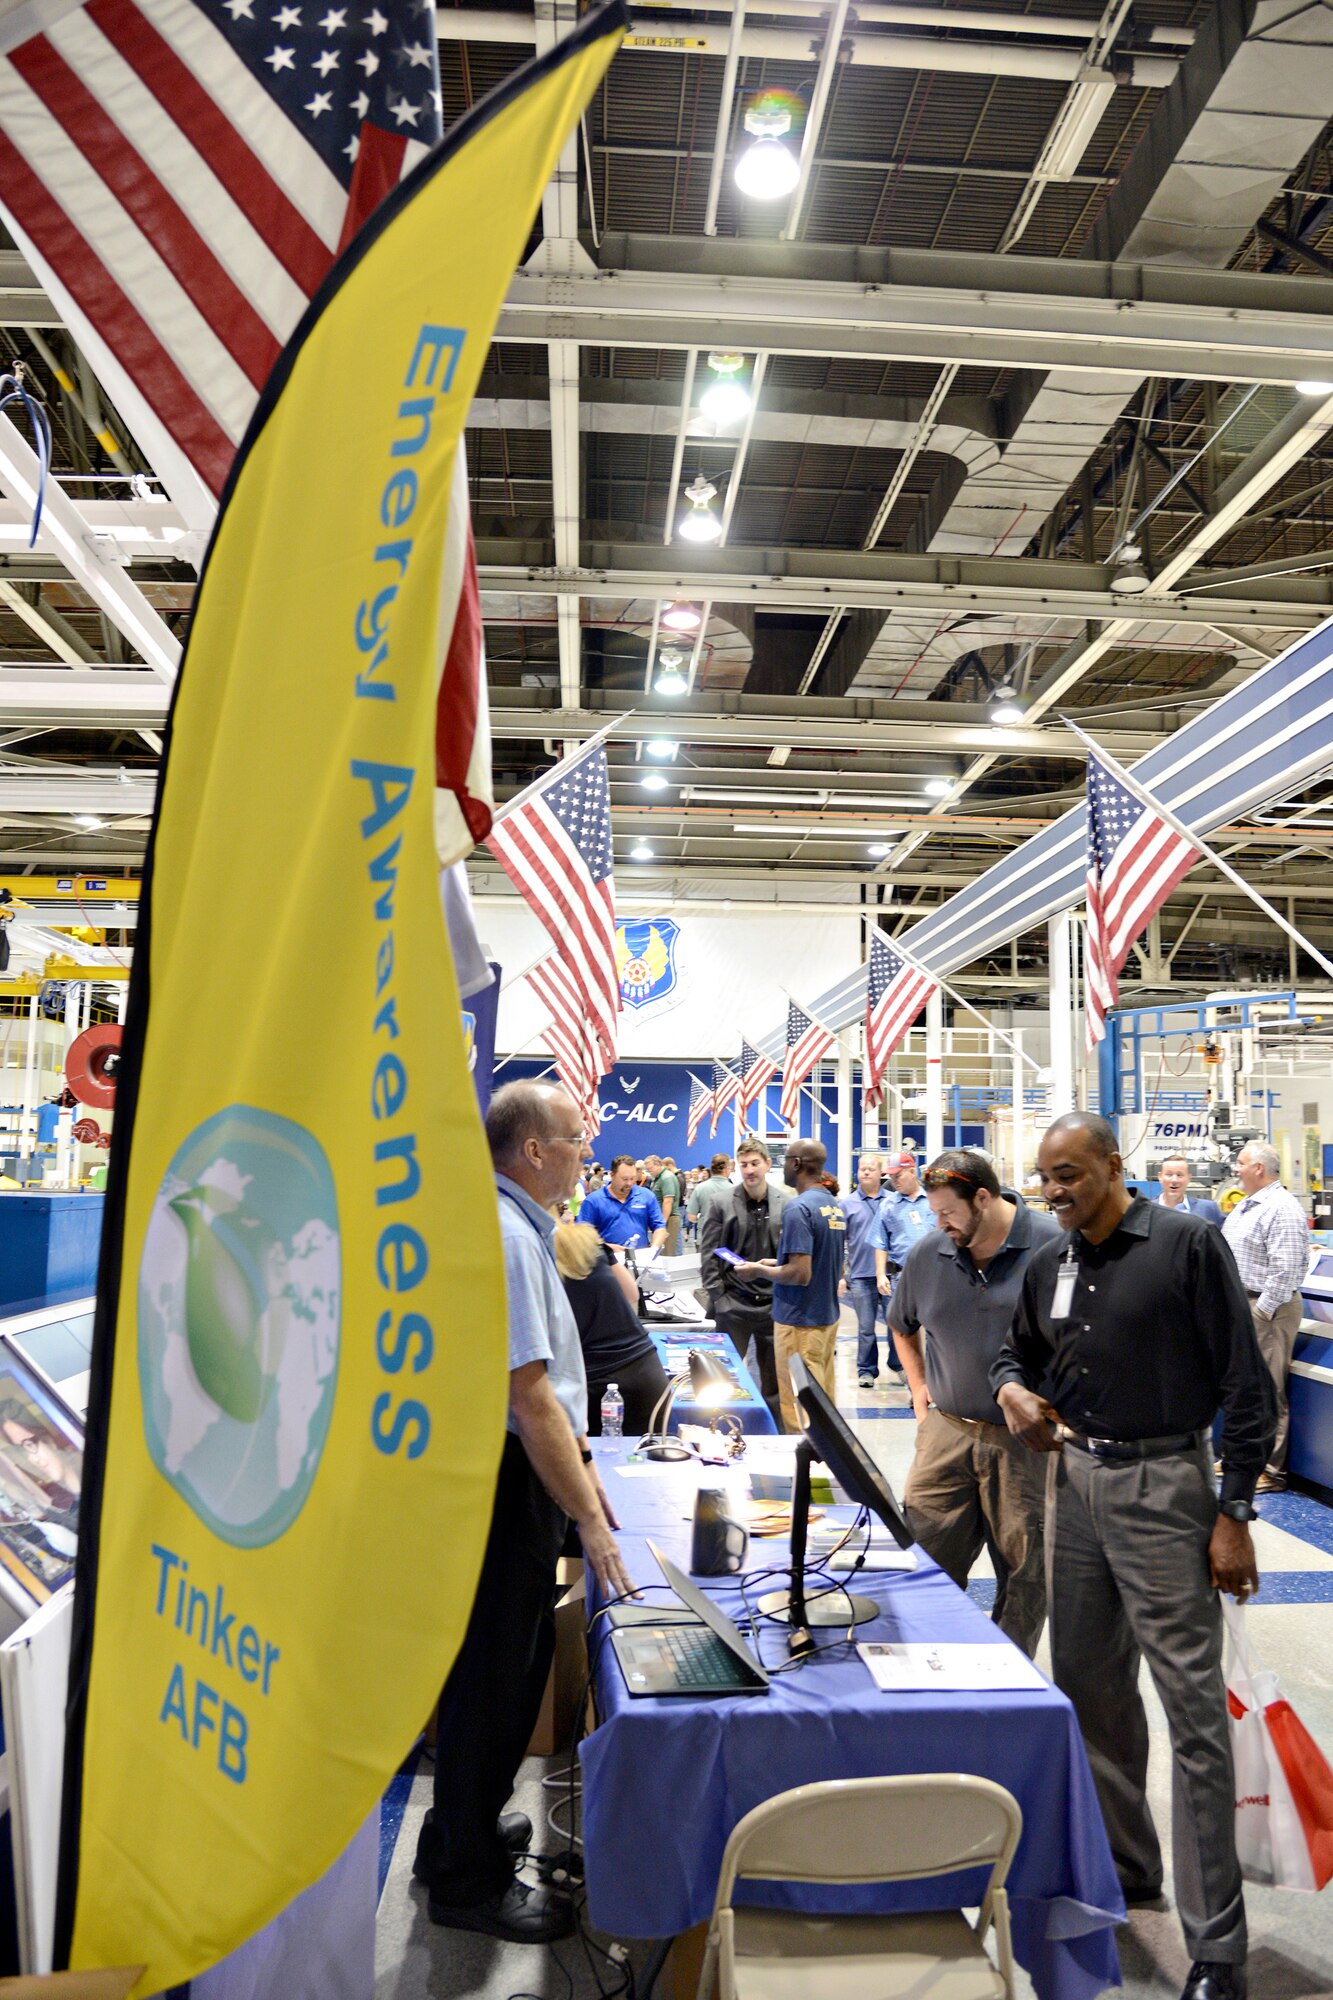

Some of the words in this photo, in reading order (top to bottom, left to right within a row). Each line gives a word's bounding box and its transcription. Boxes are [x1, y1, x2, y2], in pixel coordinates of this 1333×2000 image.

[354, 323, 468, 703] Energy
[349, 758, 435, 1461] Awareness
[151, 1542, 281, 1698] Tinker
[158, 1661, 249, 1787] AFB
